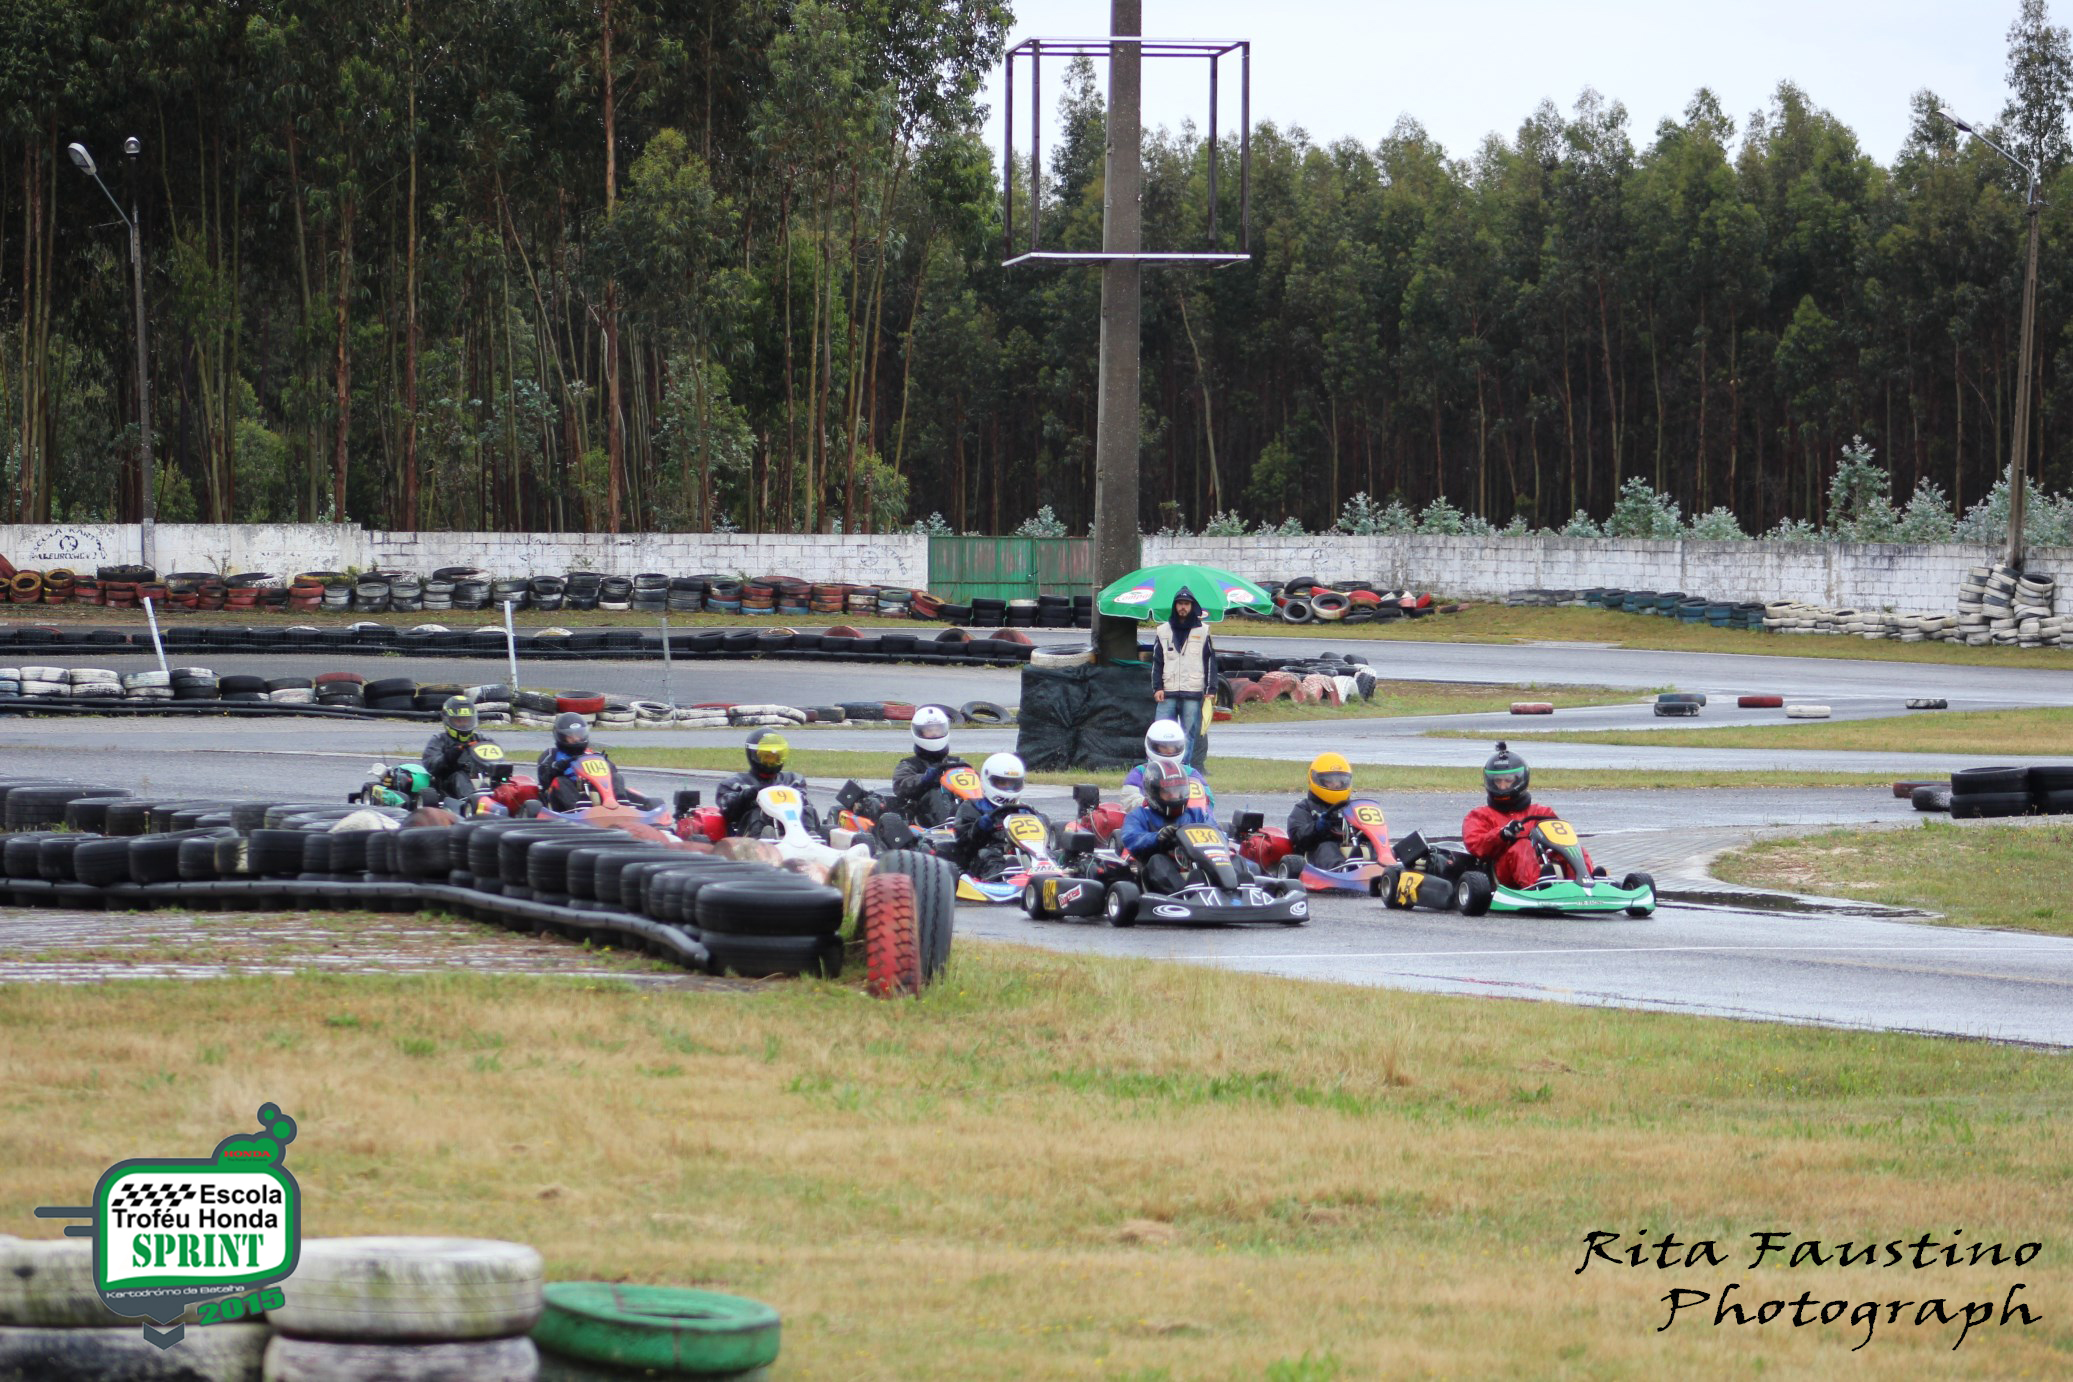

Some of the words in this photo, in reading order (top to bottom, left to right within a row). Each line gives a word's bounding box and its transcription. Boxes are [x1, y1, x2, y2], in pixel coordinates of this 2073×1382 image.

[478, 747, 499, 757] 74
[584, 761, 607, 774] 104
[954, 773, 977, 787] 67
[776, 790, 787, 803] 9
[1358, 807, 1383, 822] 63
[1010, 819, 1041, 835] 25
[1551, 821, 1568, 836] 8
[1187, 829, 1220, 844] 136
